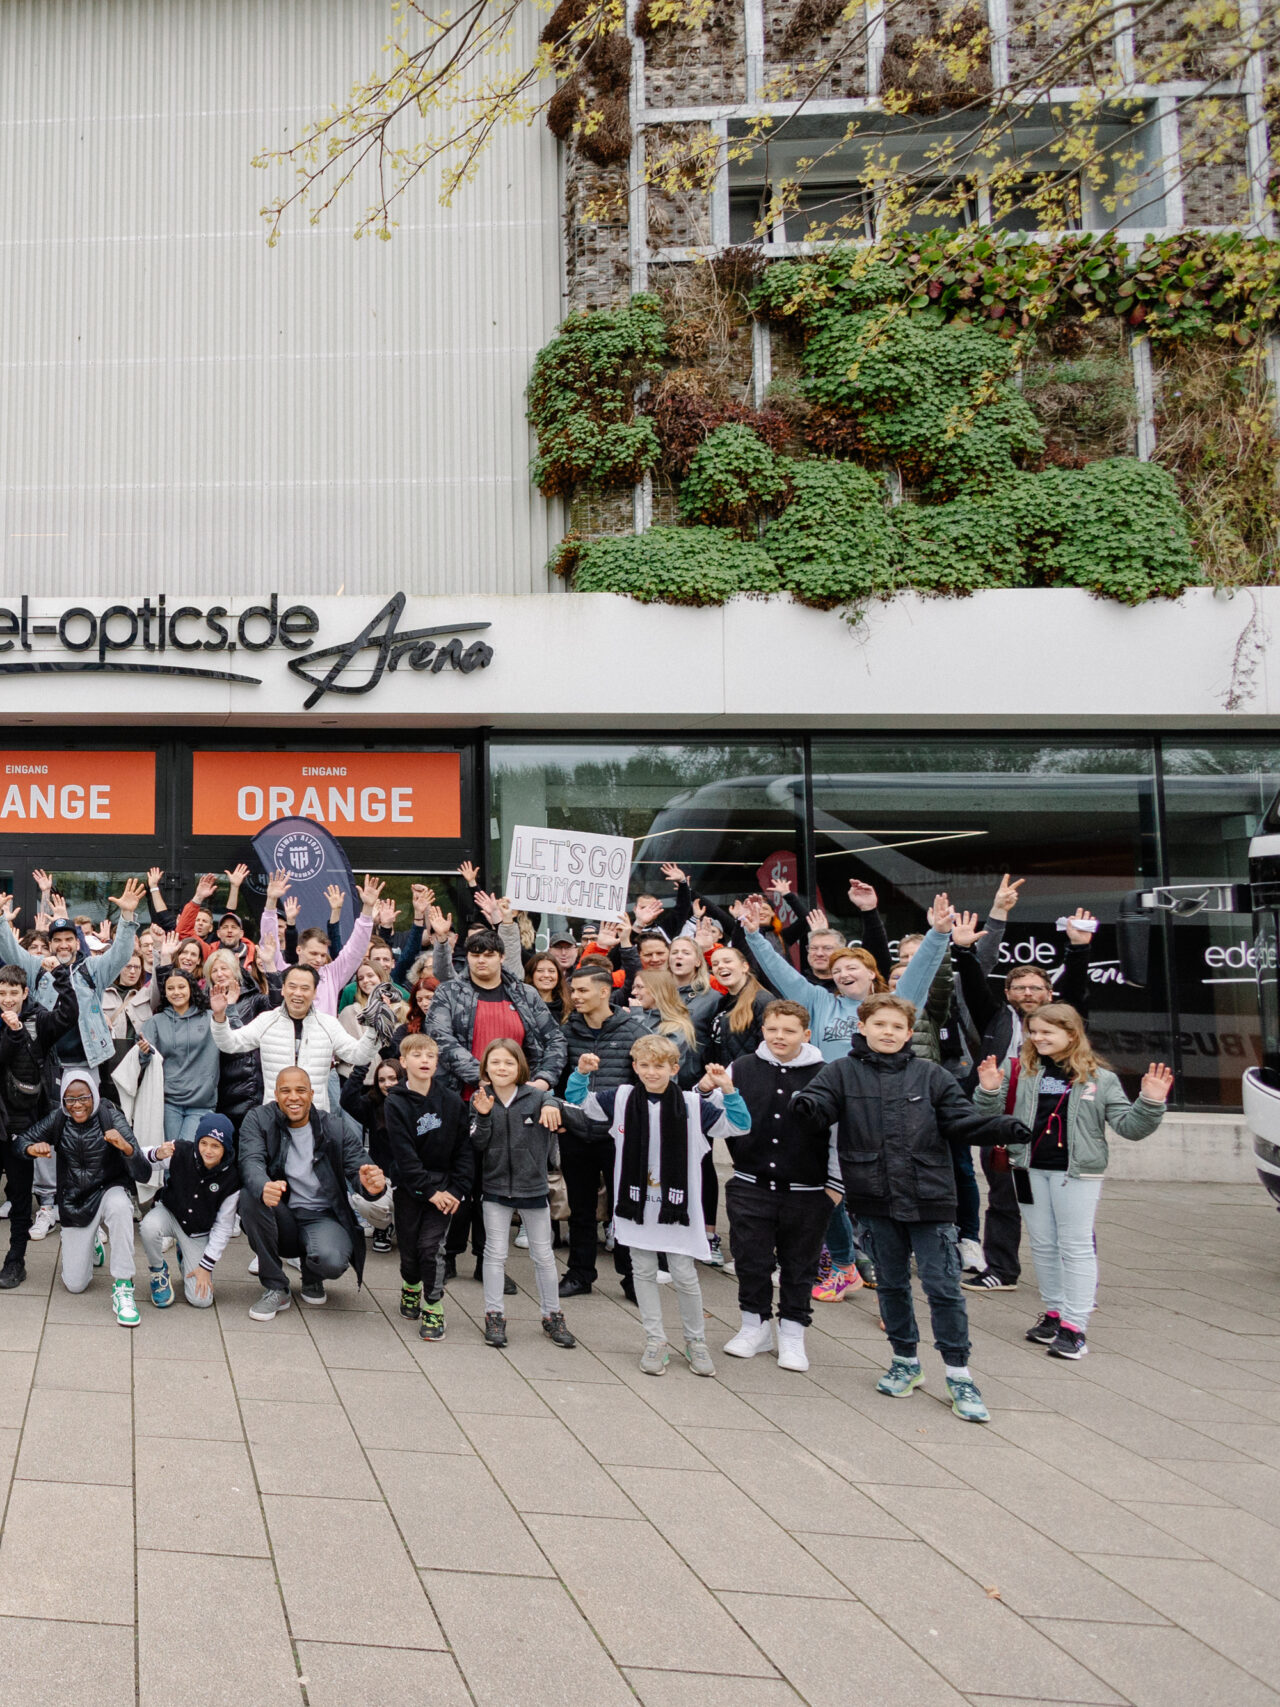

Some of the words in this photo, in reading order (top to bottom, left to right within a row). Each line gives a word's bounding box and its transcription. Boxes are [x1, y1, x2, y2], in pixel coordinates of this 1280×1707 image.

[287, 591, 494, 711] Arena
[5, 765, 49, 775] EINGANG
[301, 766, 347, 776] EINGANG
[237, 785, 414, 823] ORANGE
[515, 836, 586, 874] LET'S
[588, 845, 627, 881] GO
